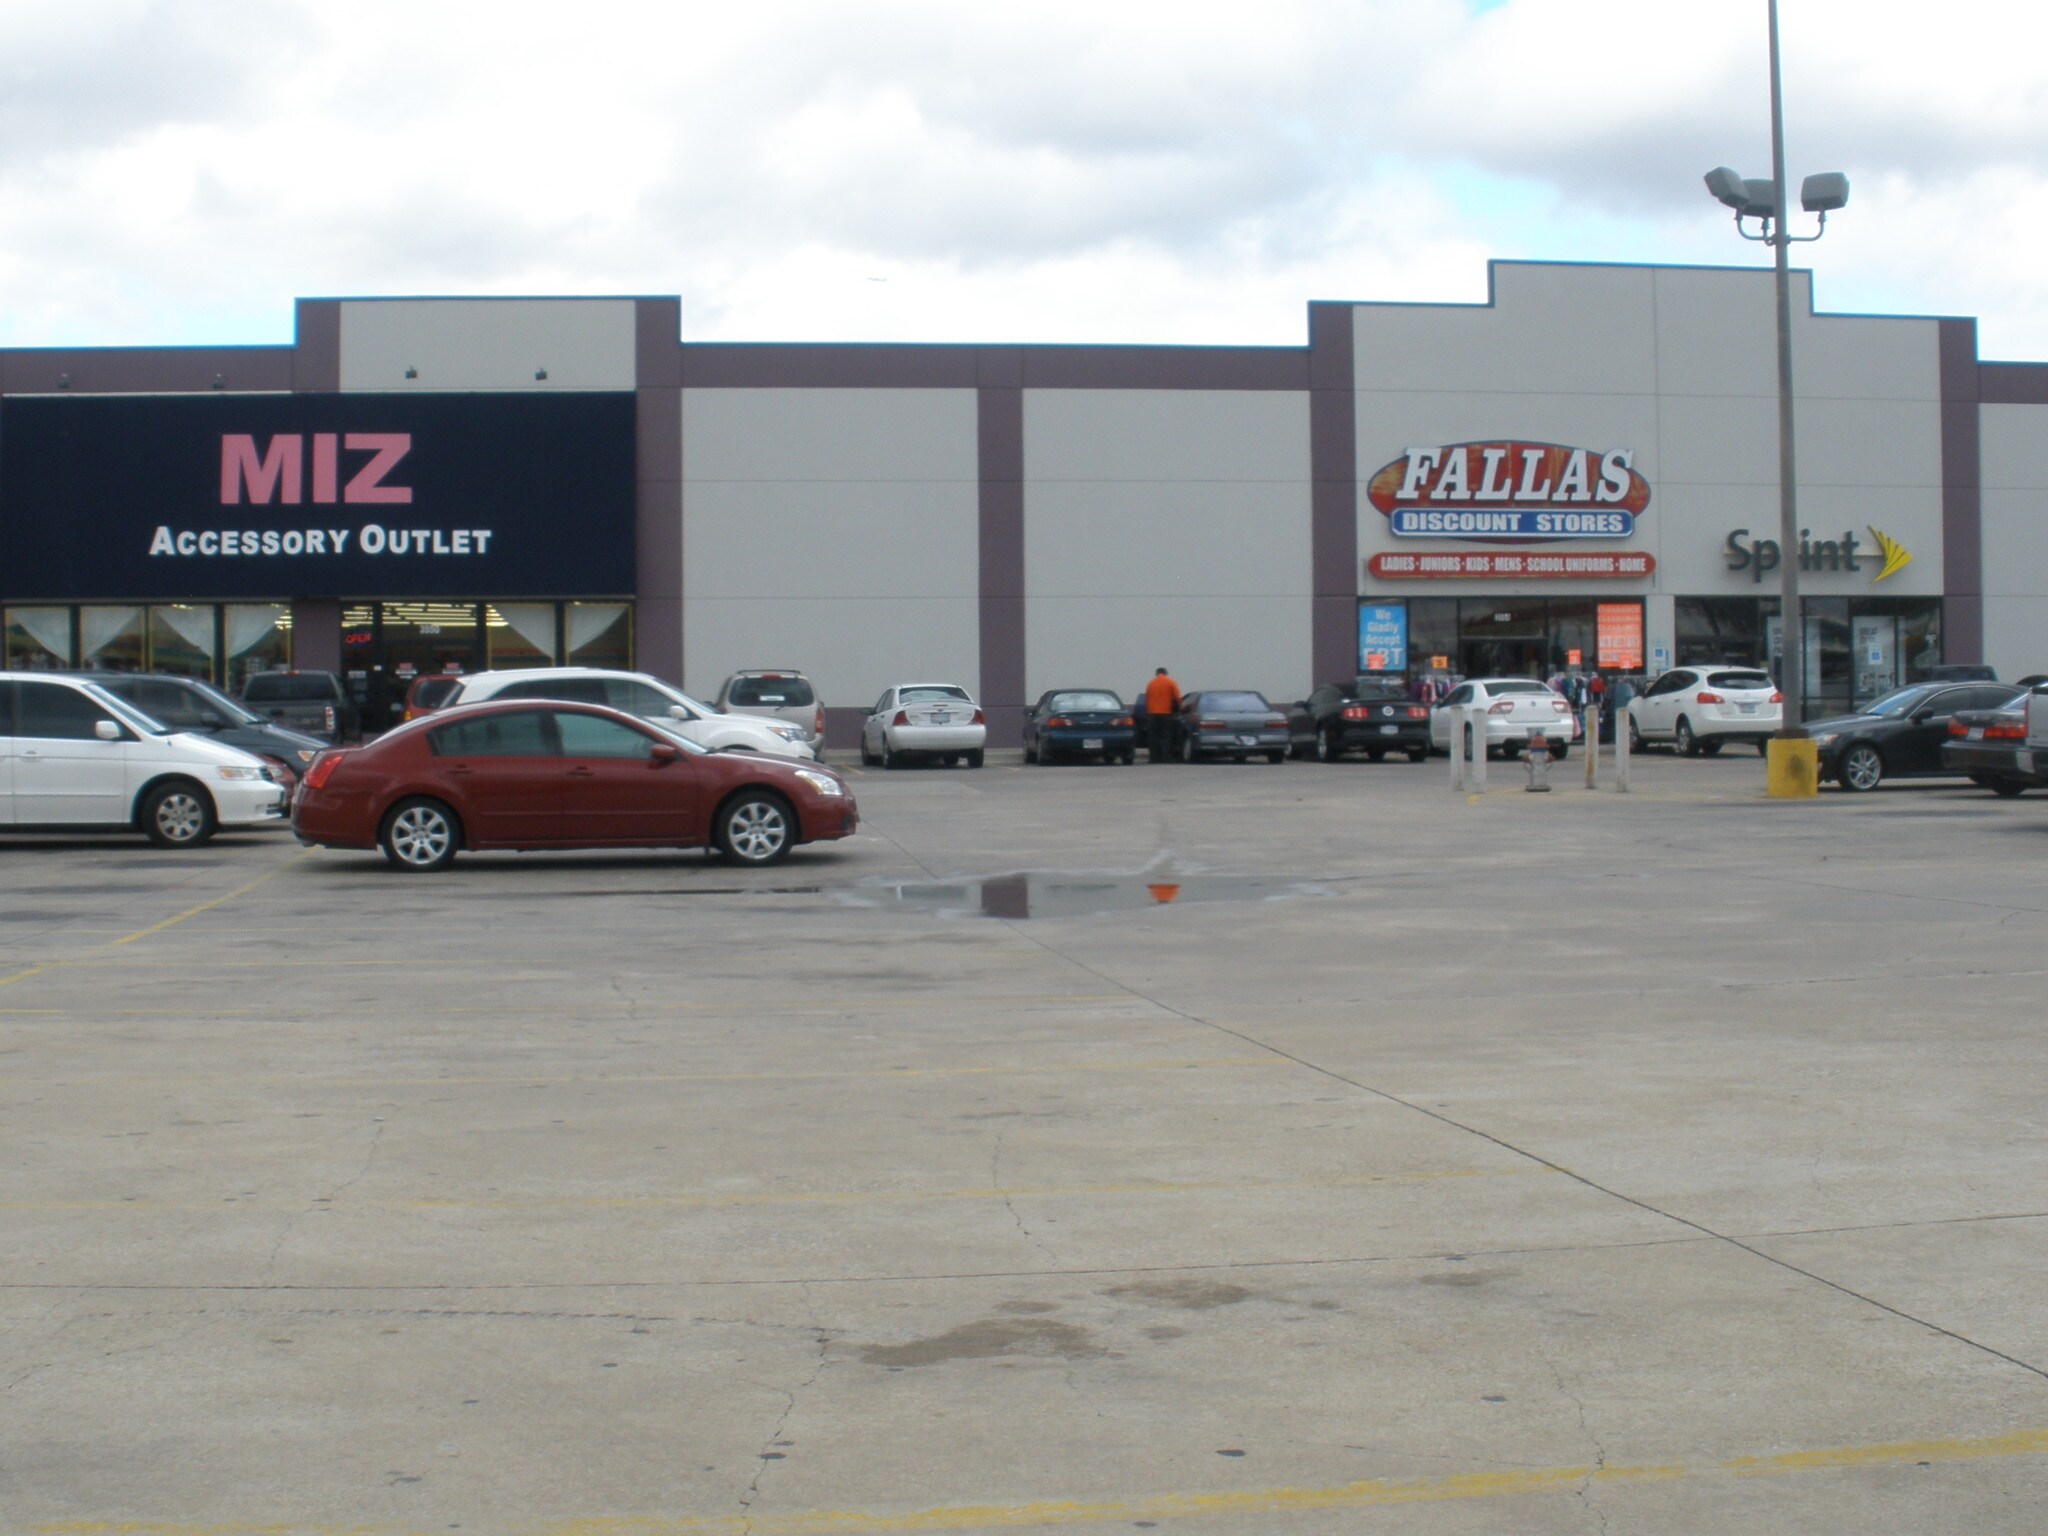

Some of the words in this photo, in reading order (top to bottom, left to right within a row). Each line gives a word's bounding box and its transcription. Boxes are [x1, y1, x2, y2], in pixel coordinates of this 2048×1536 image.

[220, 433, 413, 504] MIZ
[1396, 447, 1634, 502] FALLAS
[1402, 513, 1521, 531] DISCOUNT
[1536, 514, 1624, 532] STORES
[1727, 528, 1861, 583] Spint
[1380, 556, 1415, 571] LADIES
[1420, 556, 1461, 571] JUNIORS
[1465, 556, 1490, 571] KIDS
[1495, 557, 1522, 571] MENS
[1526, 557, 1565, 571] SCHOOL
[1566, 557, 1614, 572] UNIFORMS
[1619, 557, 1646, 572] HOME
[1375, 609, 1391, 620] We
[1367, 621, 1399, 634] Gladly
[346, 632, 371, 644] OPEN
[1366, 634, 1400, 647] Accept
